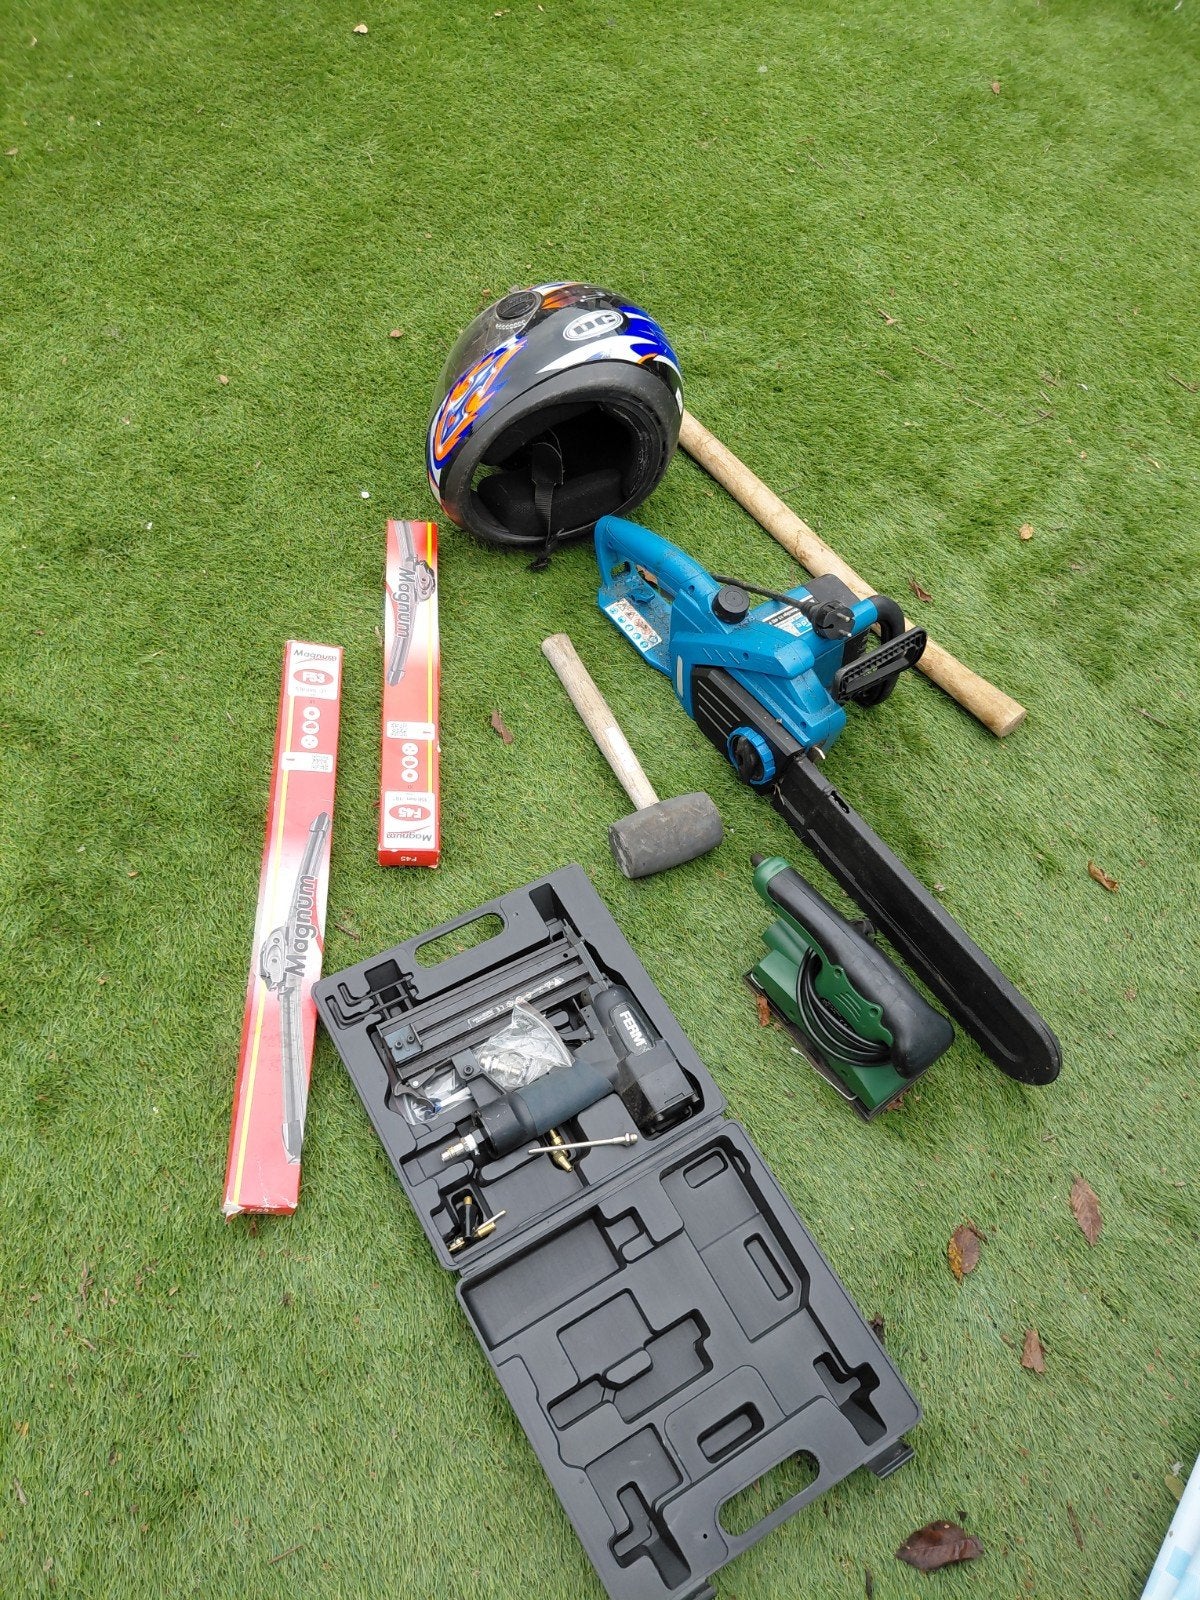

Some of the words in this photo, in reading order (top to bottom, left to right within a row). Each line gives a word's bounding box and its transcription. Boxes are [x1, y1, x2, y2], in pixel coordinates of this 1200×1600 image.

[393, 566, 416, 637] Magnum
[293, 649, 338, 662] Magnum
[398, 806, 422, 819] F45
[386, 831, 433, 842] Magnum
[284, 874, 316, 978] Magnum
[619, 1010, 647, 1047] FERM
